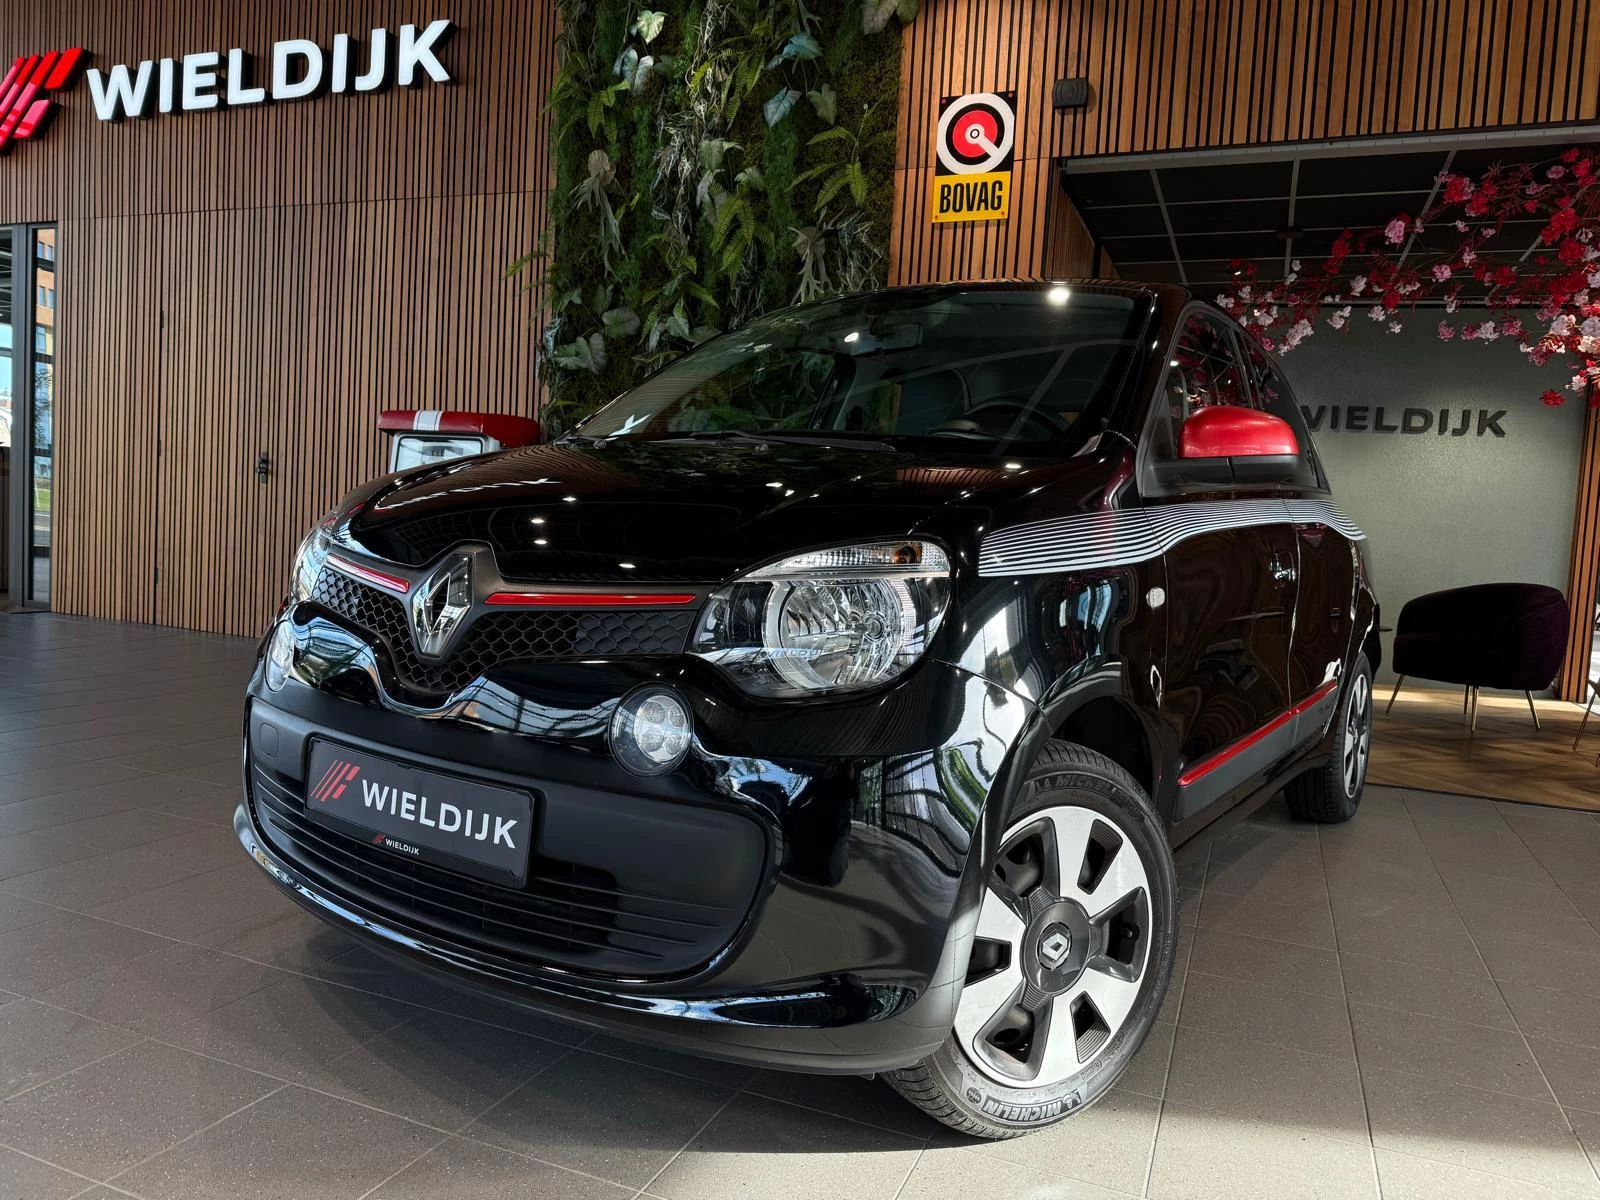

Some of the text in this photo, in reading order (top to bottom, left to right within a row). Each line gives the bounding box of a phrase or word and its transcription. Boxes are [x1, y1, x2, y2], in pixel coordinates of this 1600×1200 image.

[86, 19, 452, 121] WIELDIJK
[939, 180, 1003, 213] BOVAG
[362, 779, 518, 848] WIELDIJK
[385, 838, 420, 855] WIELDIJK
[984, 1099, 1062, 1120] MICHELIN
